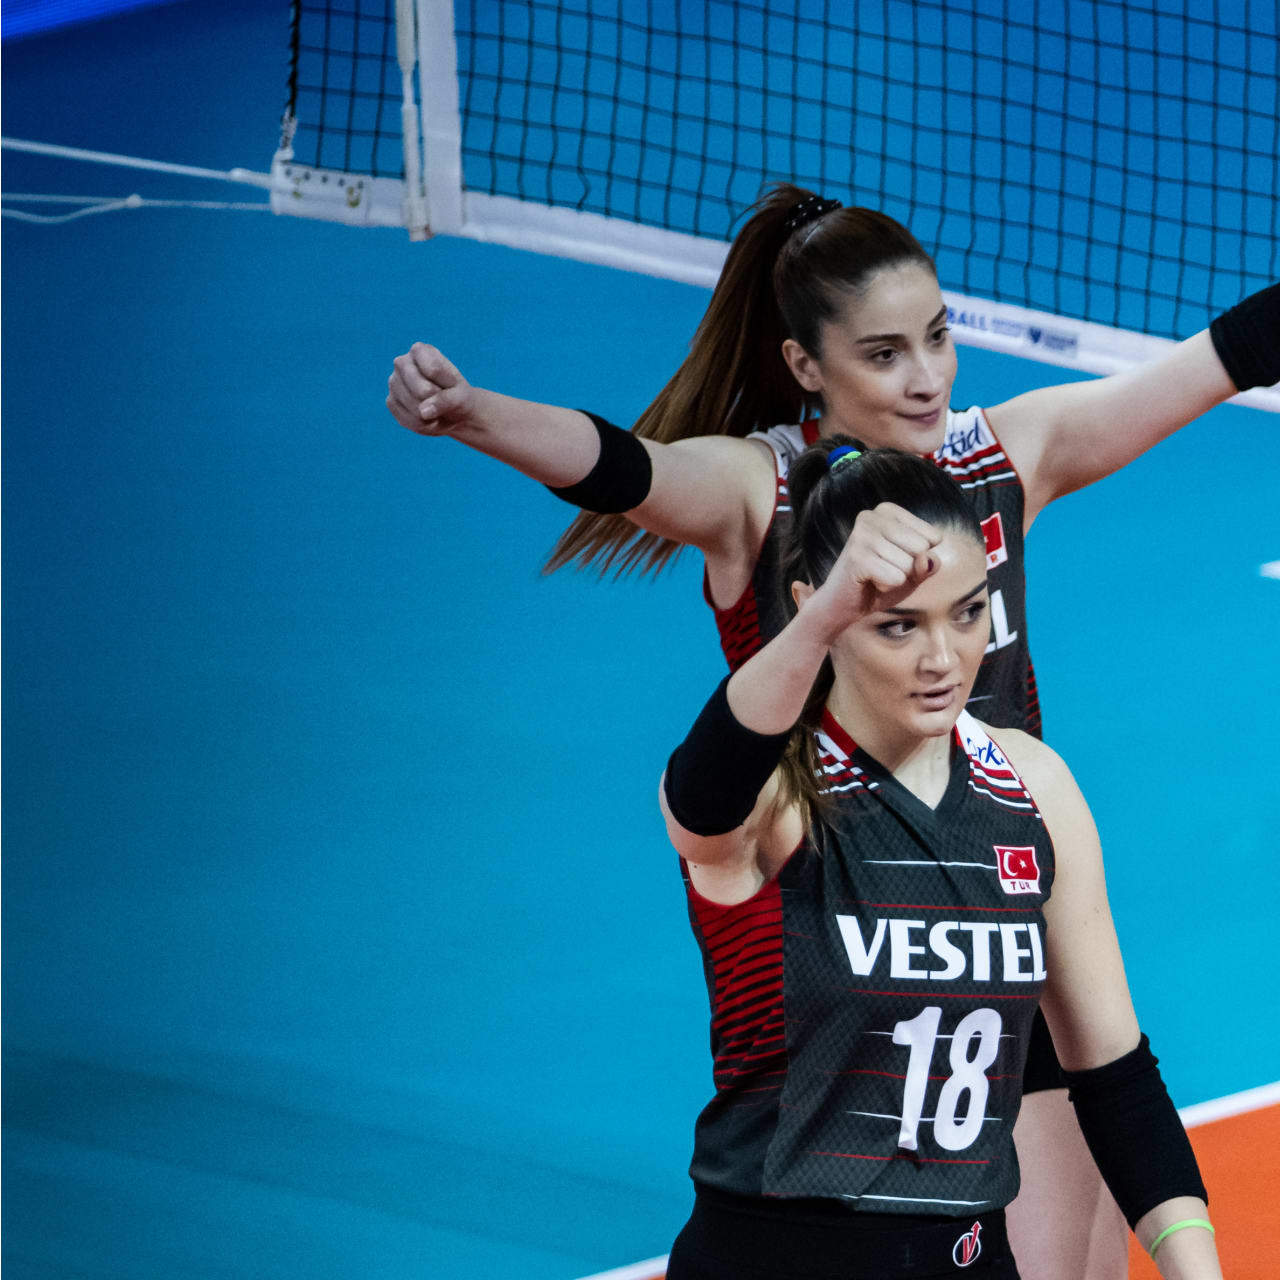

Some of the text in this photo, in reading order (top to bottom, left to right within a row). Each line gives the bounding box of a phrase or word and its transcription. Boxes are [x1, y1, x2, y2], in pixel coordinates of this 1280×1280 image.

[1010, 881, 1032, 891] TUR
[836, 914, 1047, 982] VESTEL
[892, 1006, 1003, 1151] 18
